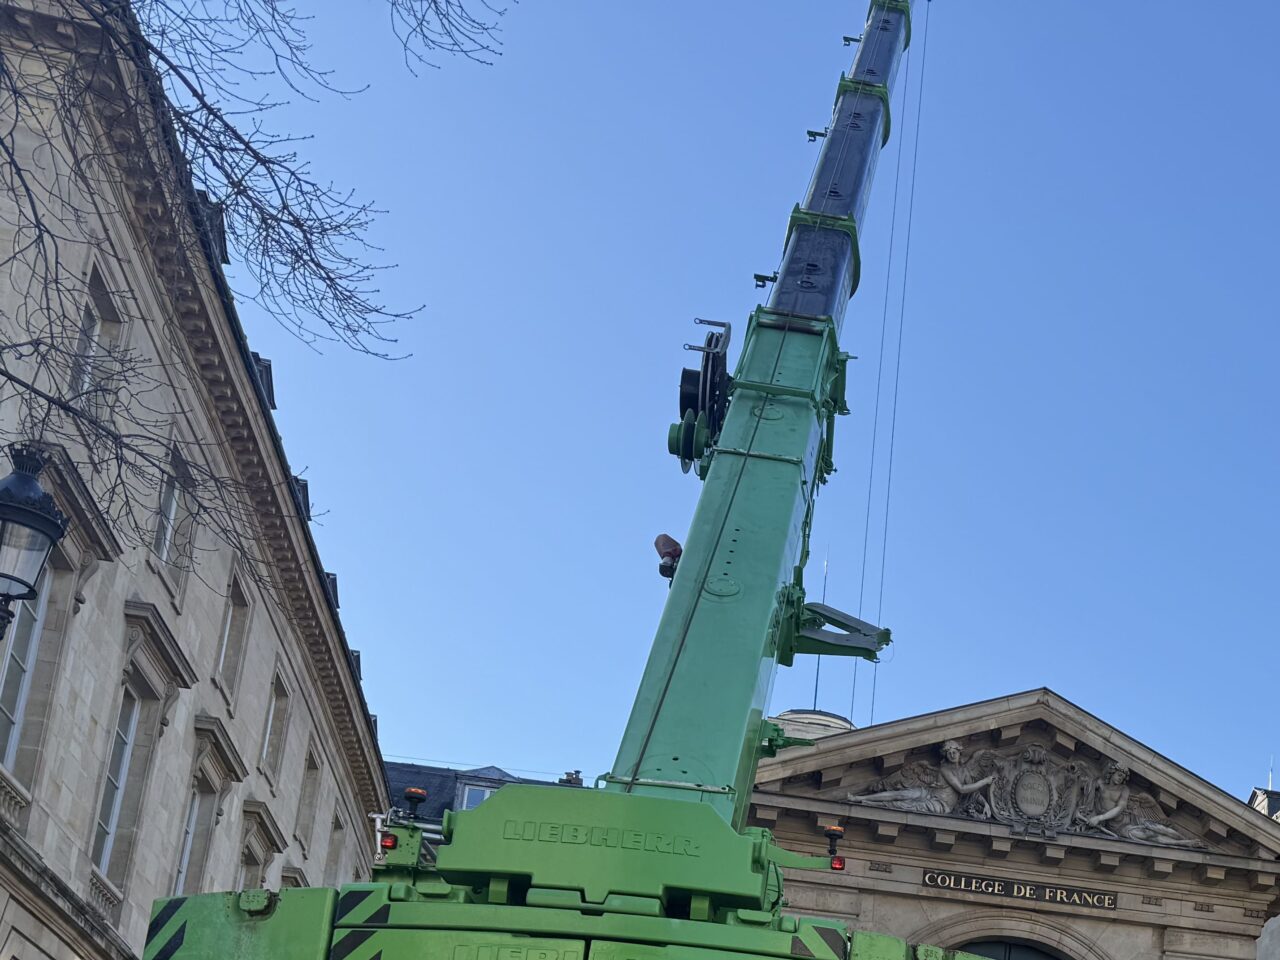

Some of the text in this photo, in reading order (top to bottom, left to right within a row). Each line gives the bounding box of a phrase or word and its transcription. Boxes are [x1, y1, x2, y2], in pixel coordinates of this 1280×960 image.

[503, 820, 700, 857] LIEBHERR
[924, 872, 1115, 908] COLLEGE DE FRANCE
